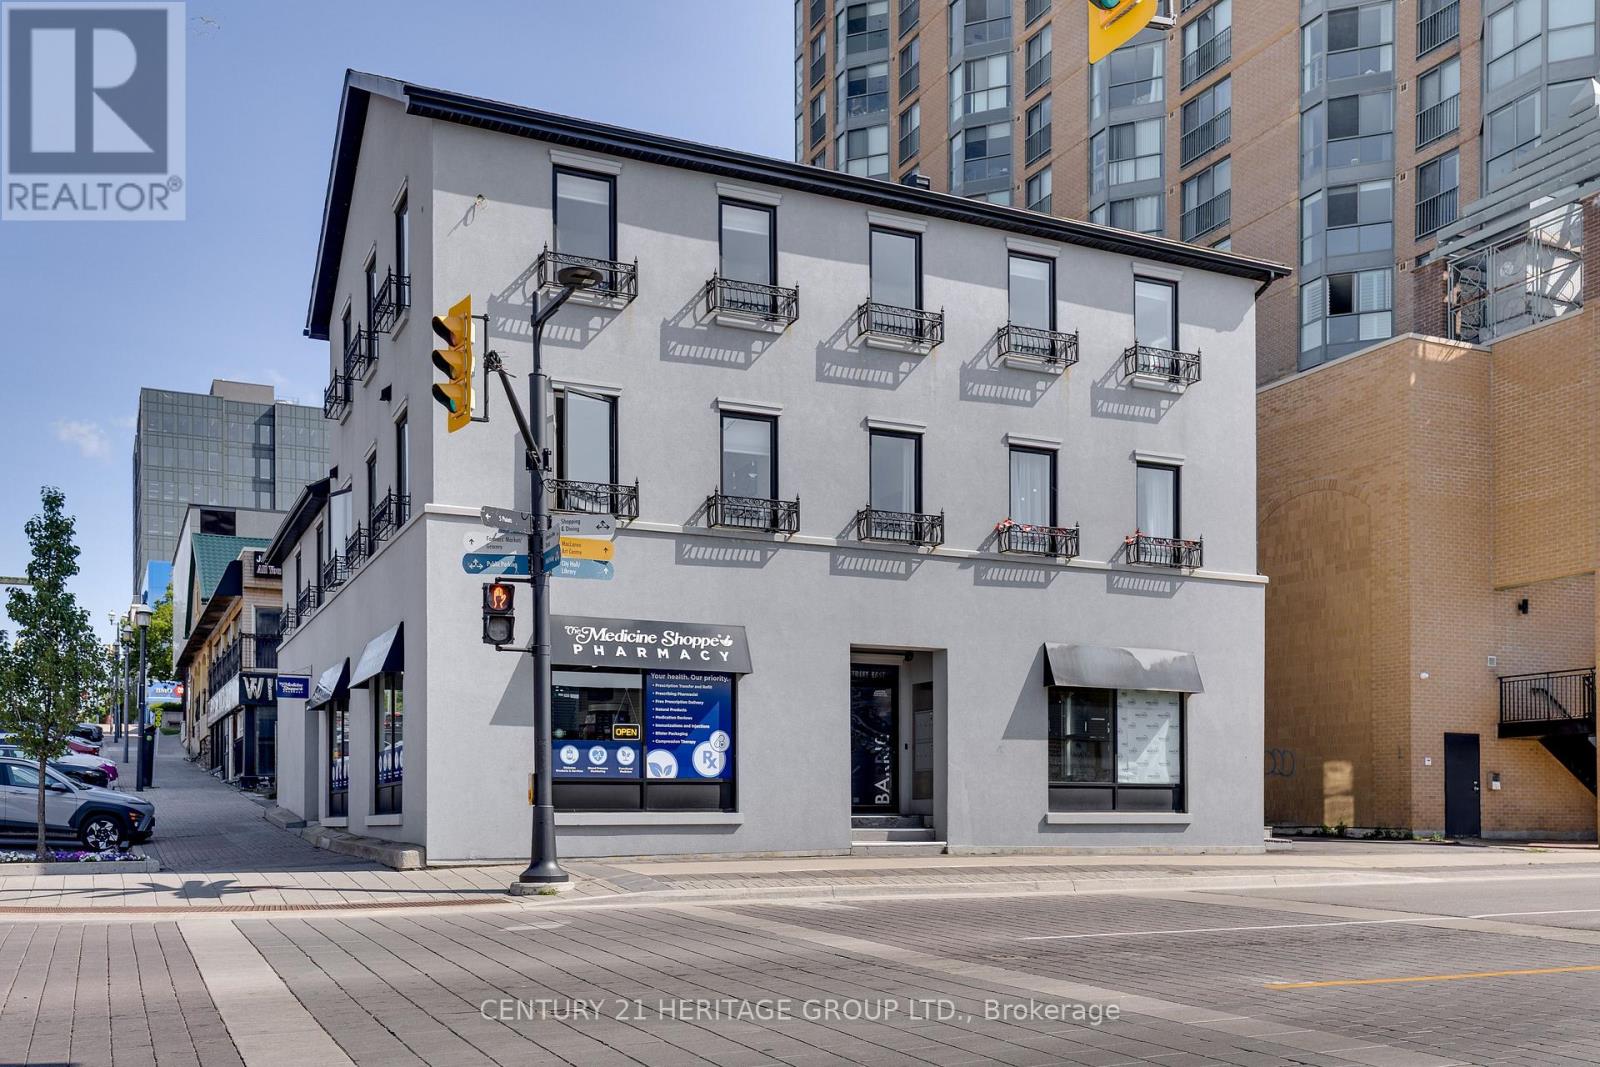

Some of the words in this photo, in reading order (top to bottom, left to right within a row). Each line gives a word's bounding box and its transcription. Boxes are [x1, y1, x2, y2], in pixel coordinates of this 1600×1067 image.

[564, 625, 582, 636] The
[576, 626, 658, 644] Medicine
[573, 644, 729, 662] PHARMACY
[242, 676, 278, 700] WI
[615, 726, 638, 736] OPEN
